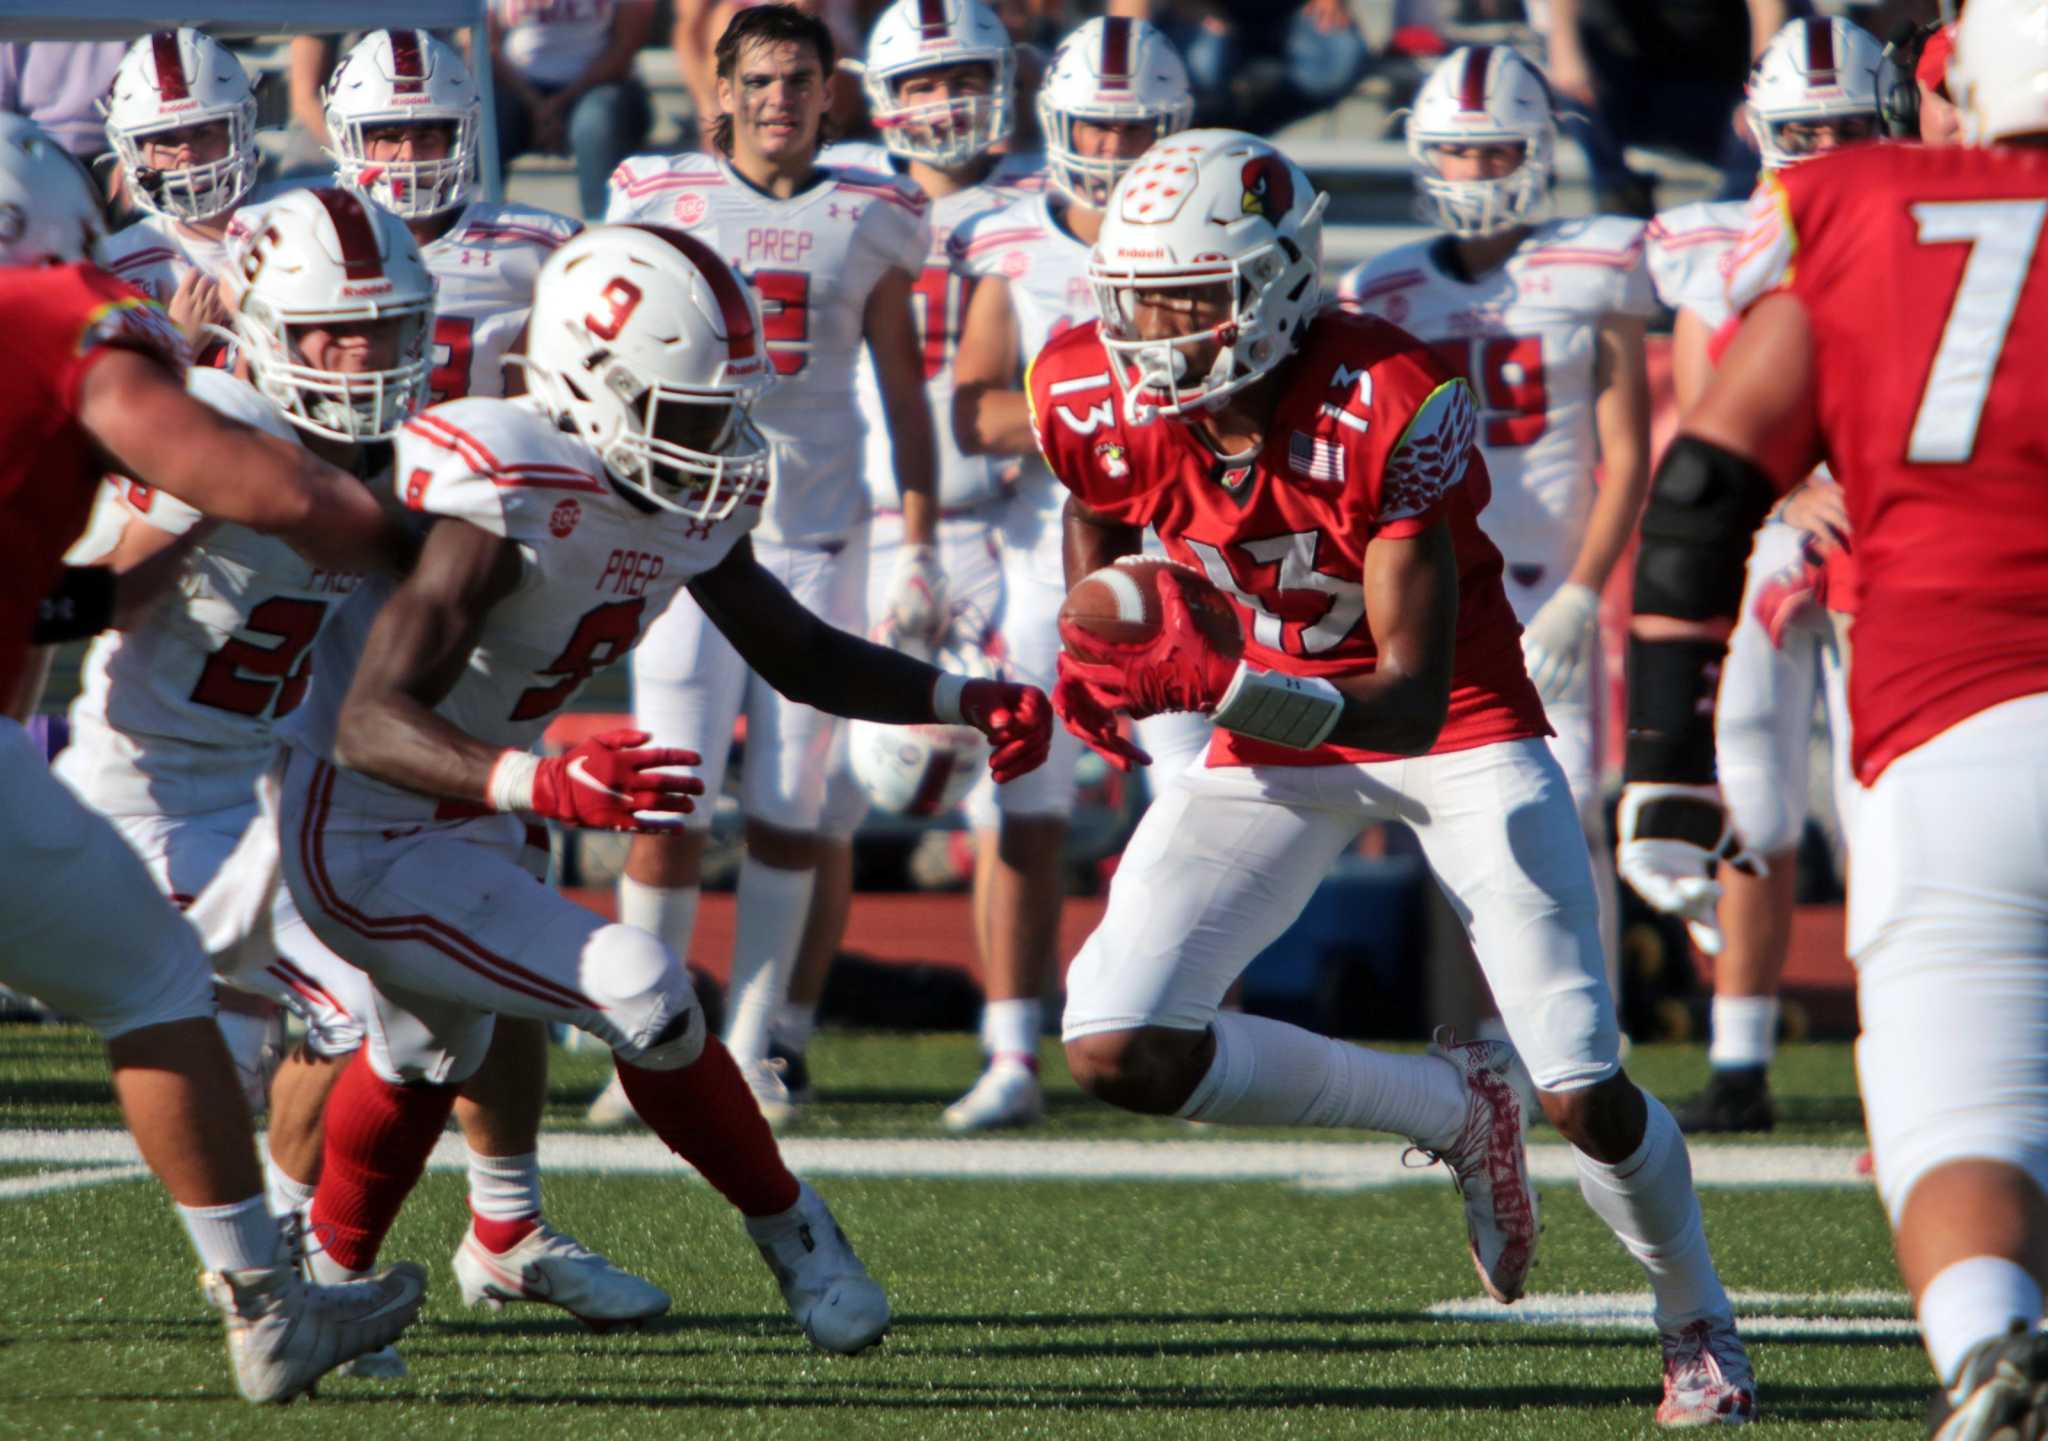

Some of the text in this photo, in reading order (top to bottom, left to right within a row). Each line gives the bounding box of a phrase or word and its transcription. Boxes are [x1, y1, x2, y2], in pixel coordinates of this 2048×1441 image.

[747, 228, 813, 262] PREP
[1117, 247, 1165, 259] Riddell
[584, 276, 643, 341] 9
[911, 264, 973, 382] 1
[1908, 200, 2048, 464] 7
[1048, 368, 1116, 436] 13
[1318, 362, 1372, 433] 13
[595, 548, 664, 598] PREP
[1184, 529, 1366, 655] 13
[508, 597, 647, 722] 9
